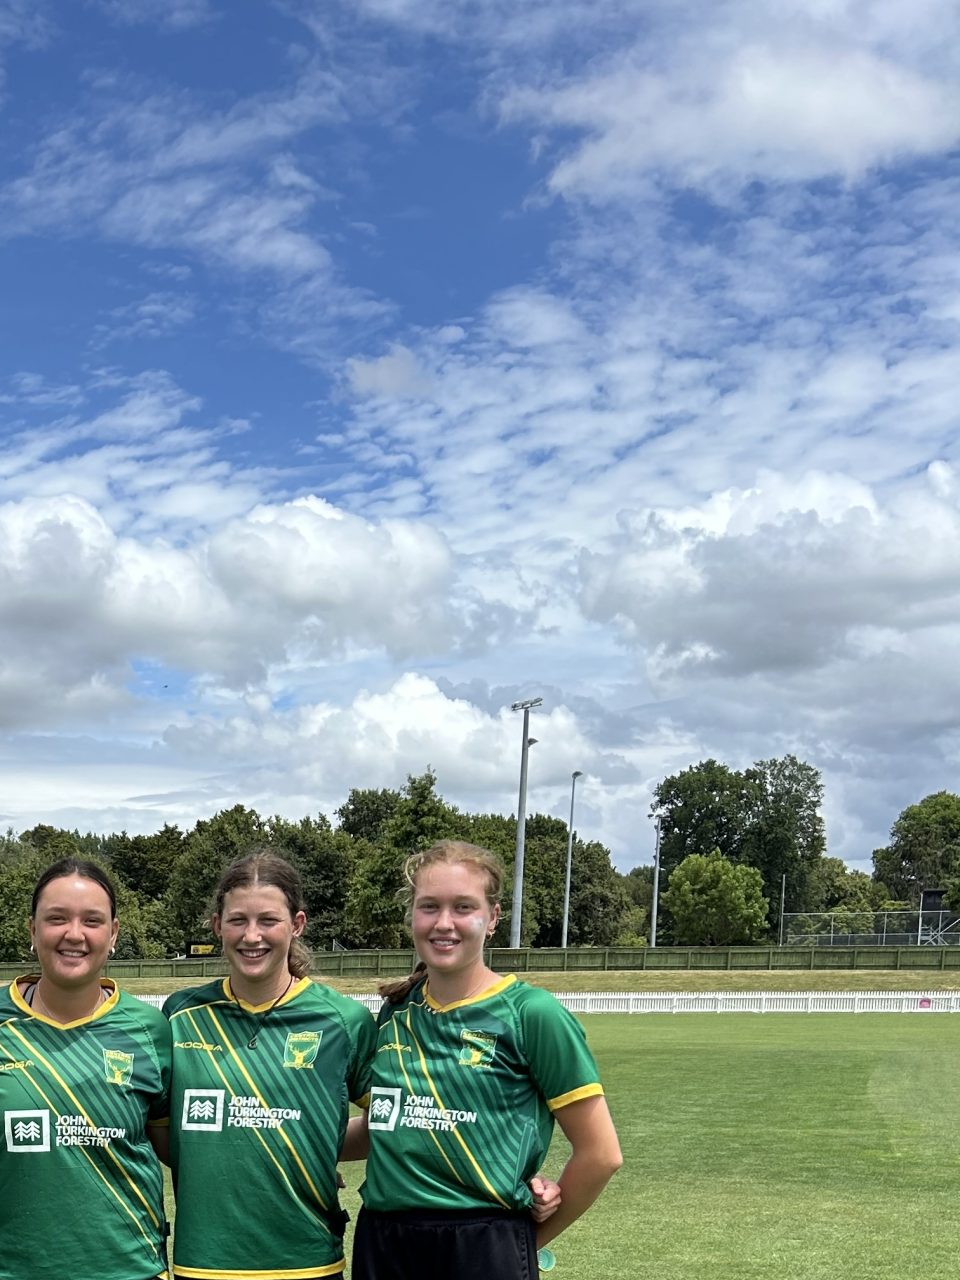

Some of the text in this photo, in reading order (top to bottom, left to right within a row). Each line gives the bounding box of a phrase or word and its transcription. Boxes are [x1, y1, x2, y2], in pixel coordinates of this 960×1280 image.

[174, 1041, 223, 1052] KOOGA
[378, 1043, 412, 1053] OOGA
[228, 1096, 260, 1108] JOHN
[404, 1095, 434, 1108] JOHN
[228, 1106, 301, 1121] TURKINGTON
[403, 1106, 478, 1123] TURKINGTON
[55, 1115, 87, 1127] JOHN
[227, 1116, 284, 1129] FORESTRY
[400, 1117, 458, 1132] FORESTRY
[55, 1125, 126, 1139] TURKINGTON
[55, 1136, 111, 1148] FORESTRY
